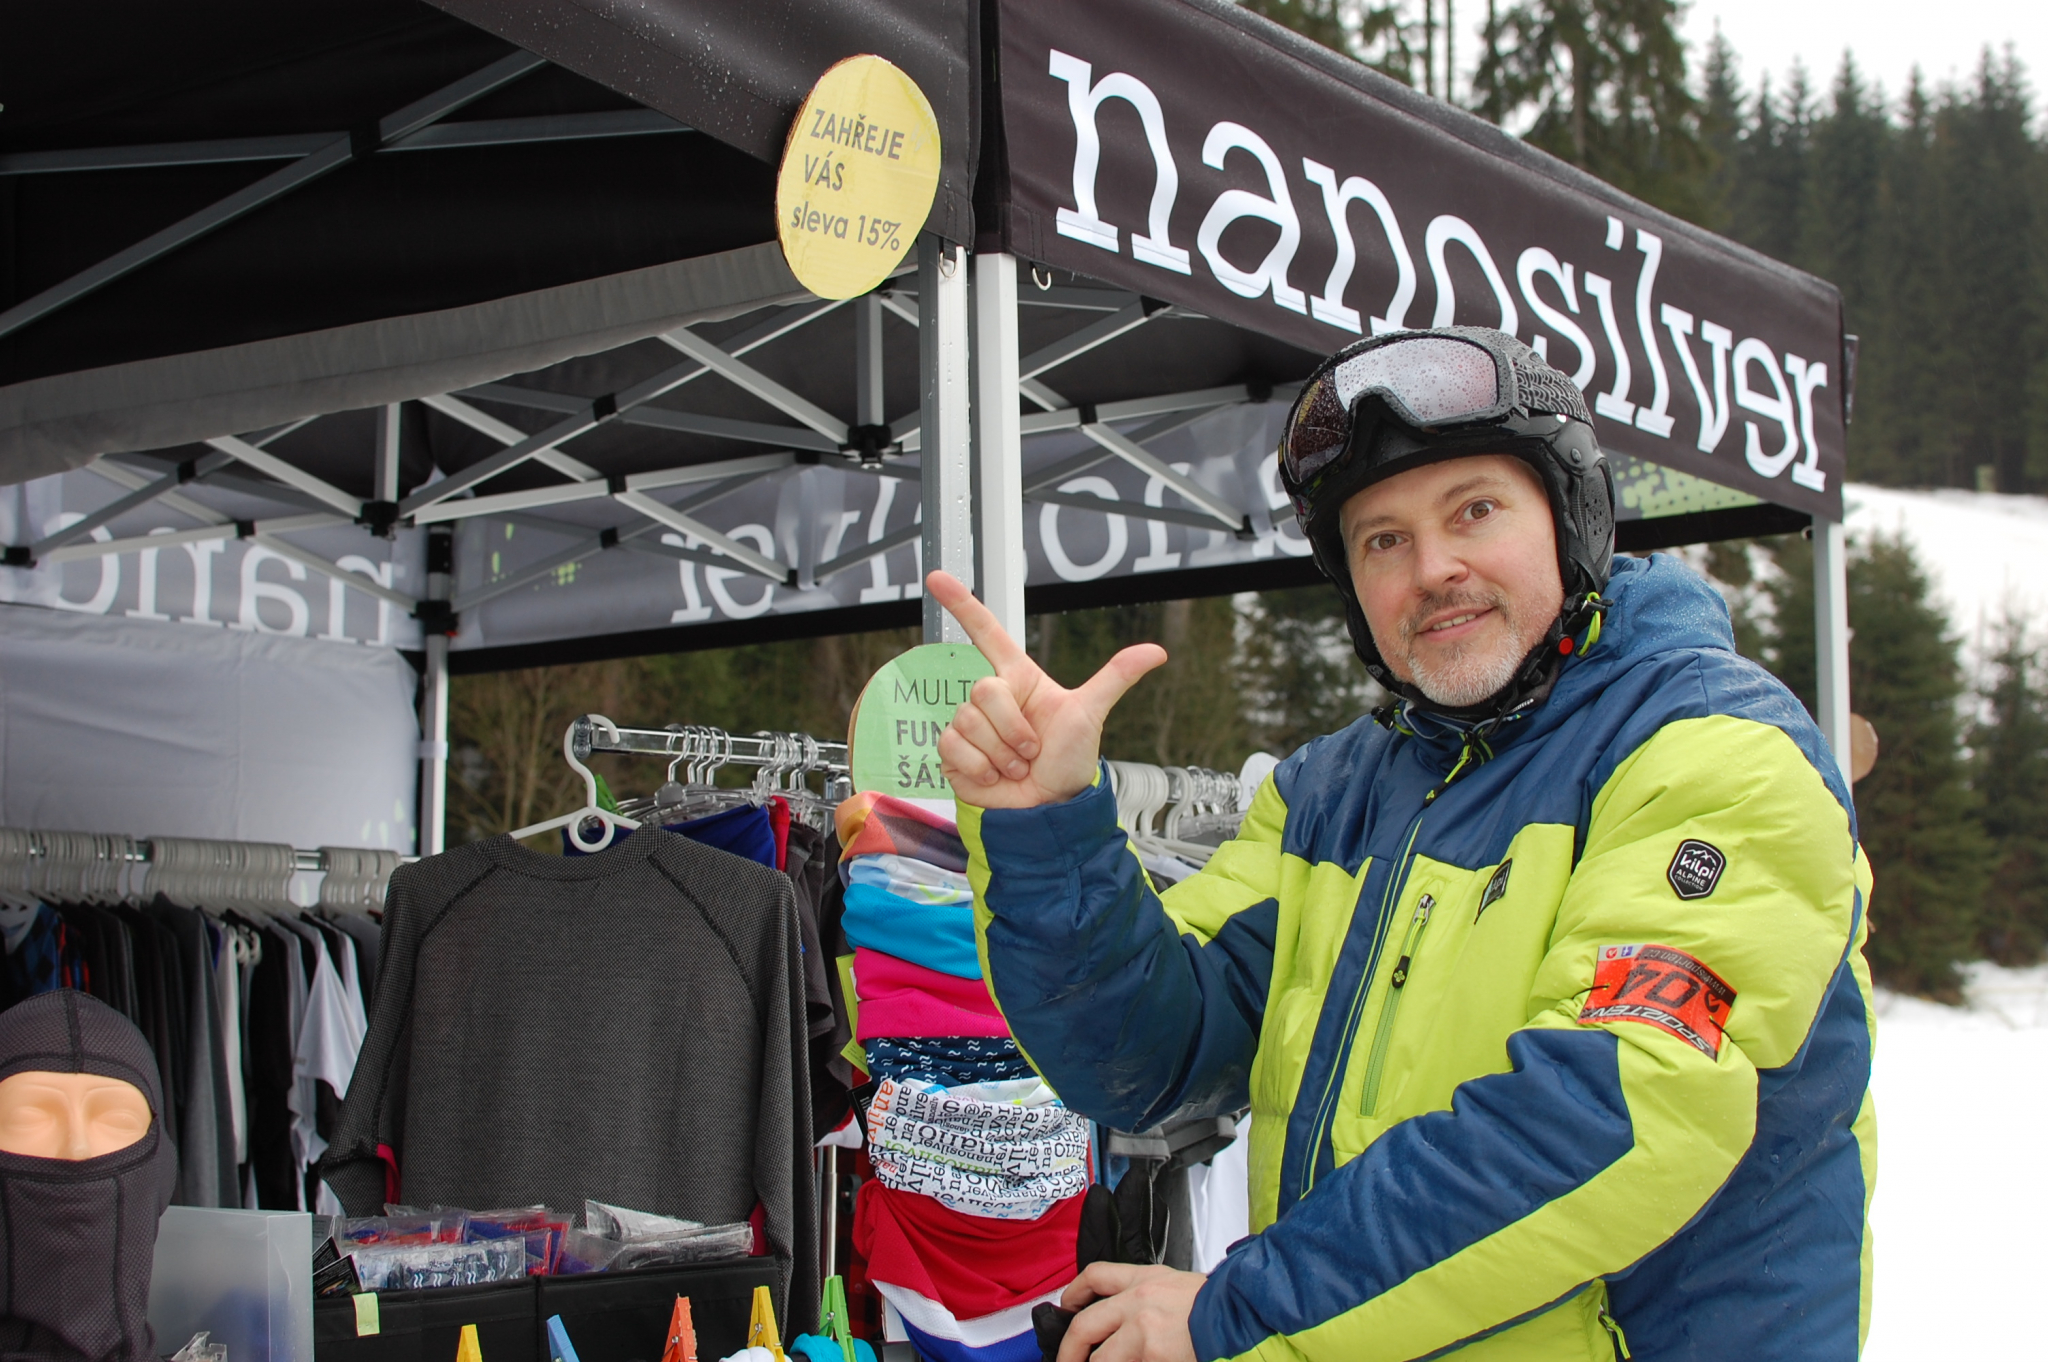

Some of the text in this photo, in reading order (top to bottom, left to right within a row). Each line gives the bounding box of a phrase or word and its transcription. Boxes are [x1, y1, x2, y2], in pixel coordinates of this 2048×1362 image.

[810, 109, 905, 160] ZAHŘEJE
[804, 151, 845, 191] VÁS
[791, 201, 902, 252] sleva 15%
[1048, 48, 1828, 492] nanosilver
[894, 678, 977, 706] MULT
[1676, 868, 1706, 887] ALPINE
[1680, 853, 1716, 880] kilpi
